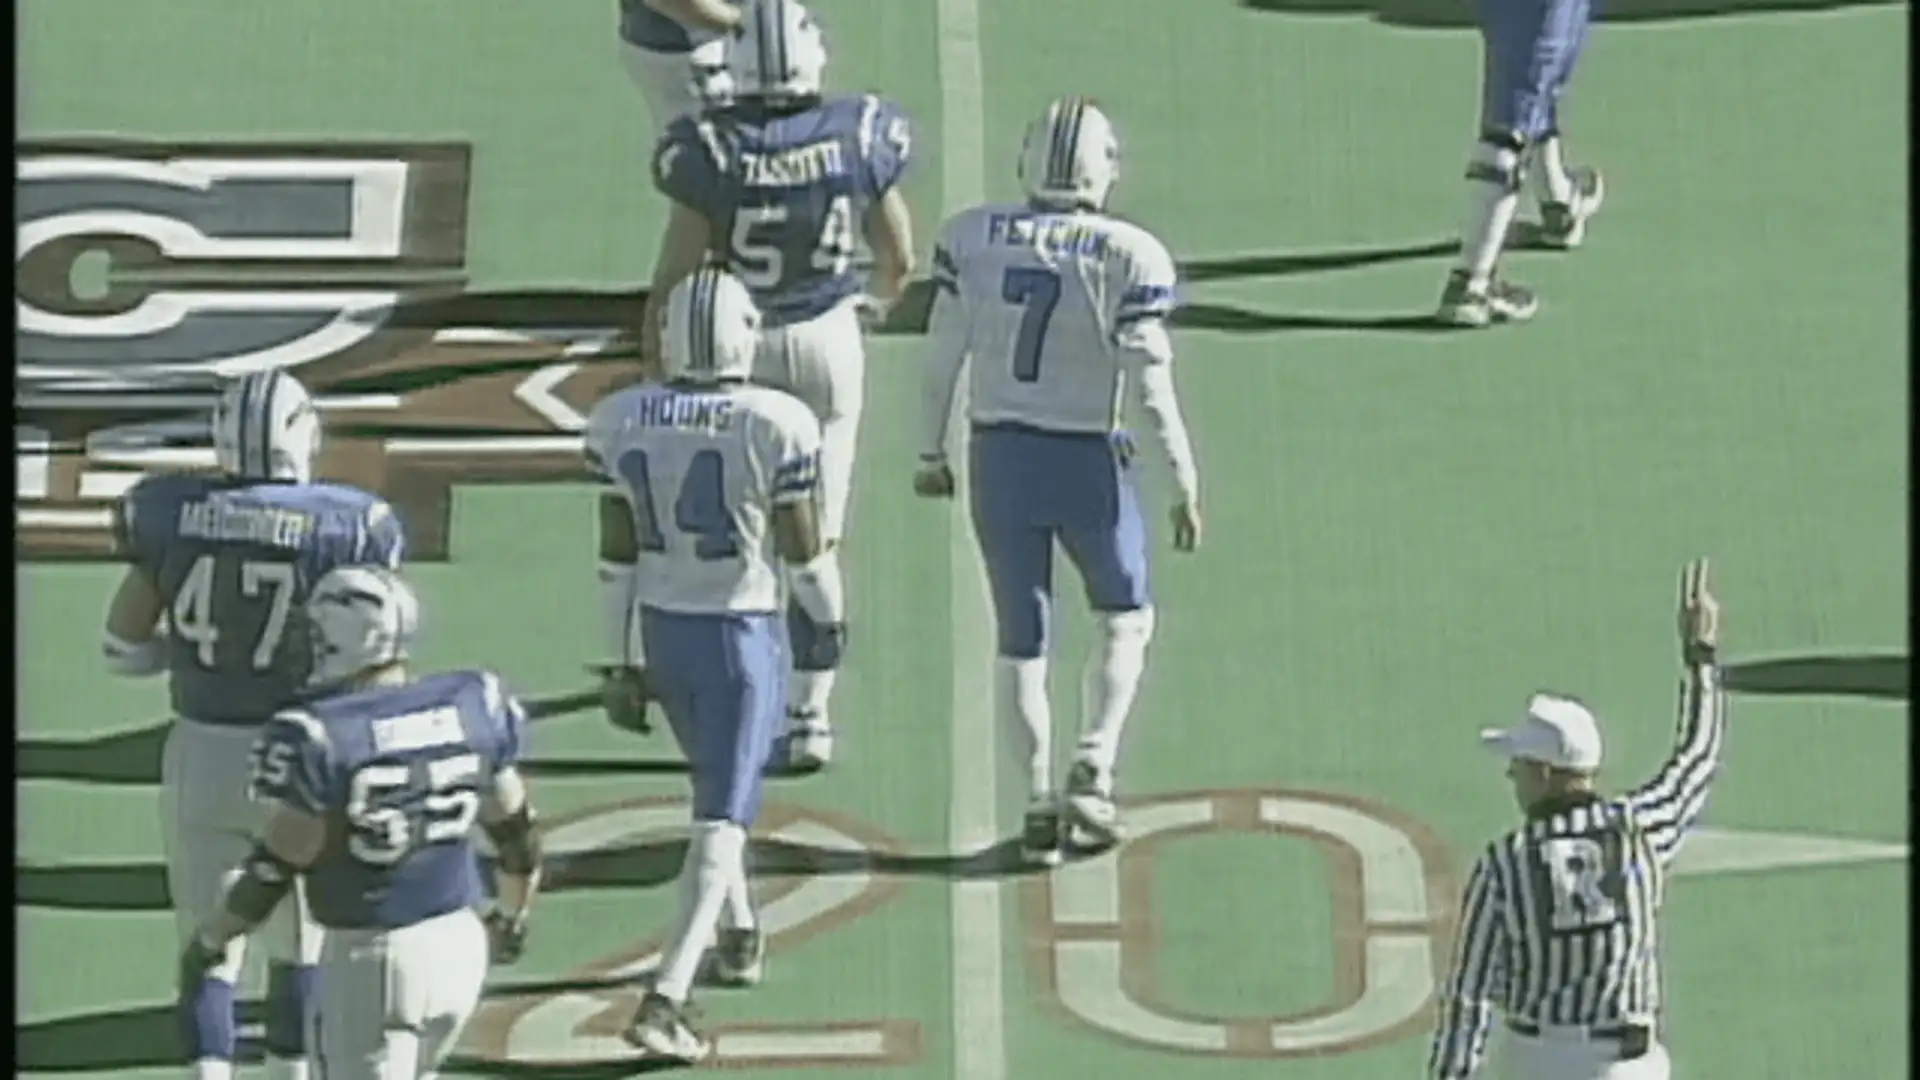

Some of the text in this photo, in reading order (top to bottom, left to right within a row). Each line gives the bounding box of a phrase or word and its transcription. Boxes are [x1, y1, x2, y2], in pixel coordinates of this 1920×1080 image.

[732, 194, 874, 288] 54
[1001, 265, 1063, 383] 7
[616, 446, 741, 561] 14
[173, 555, 296, 670] 47
[348, 754, 480, 864] 55
[1540, 837, 1618, 931] R
